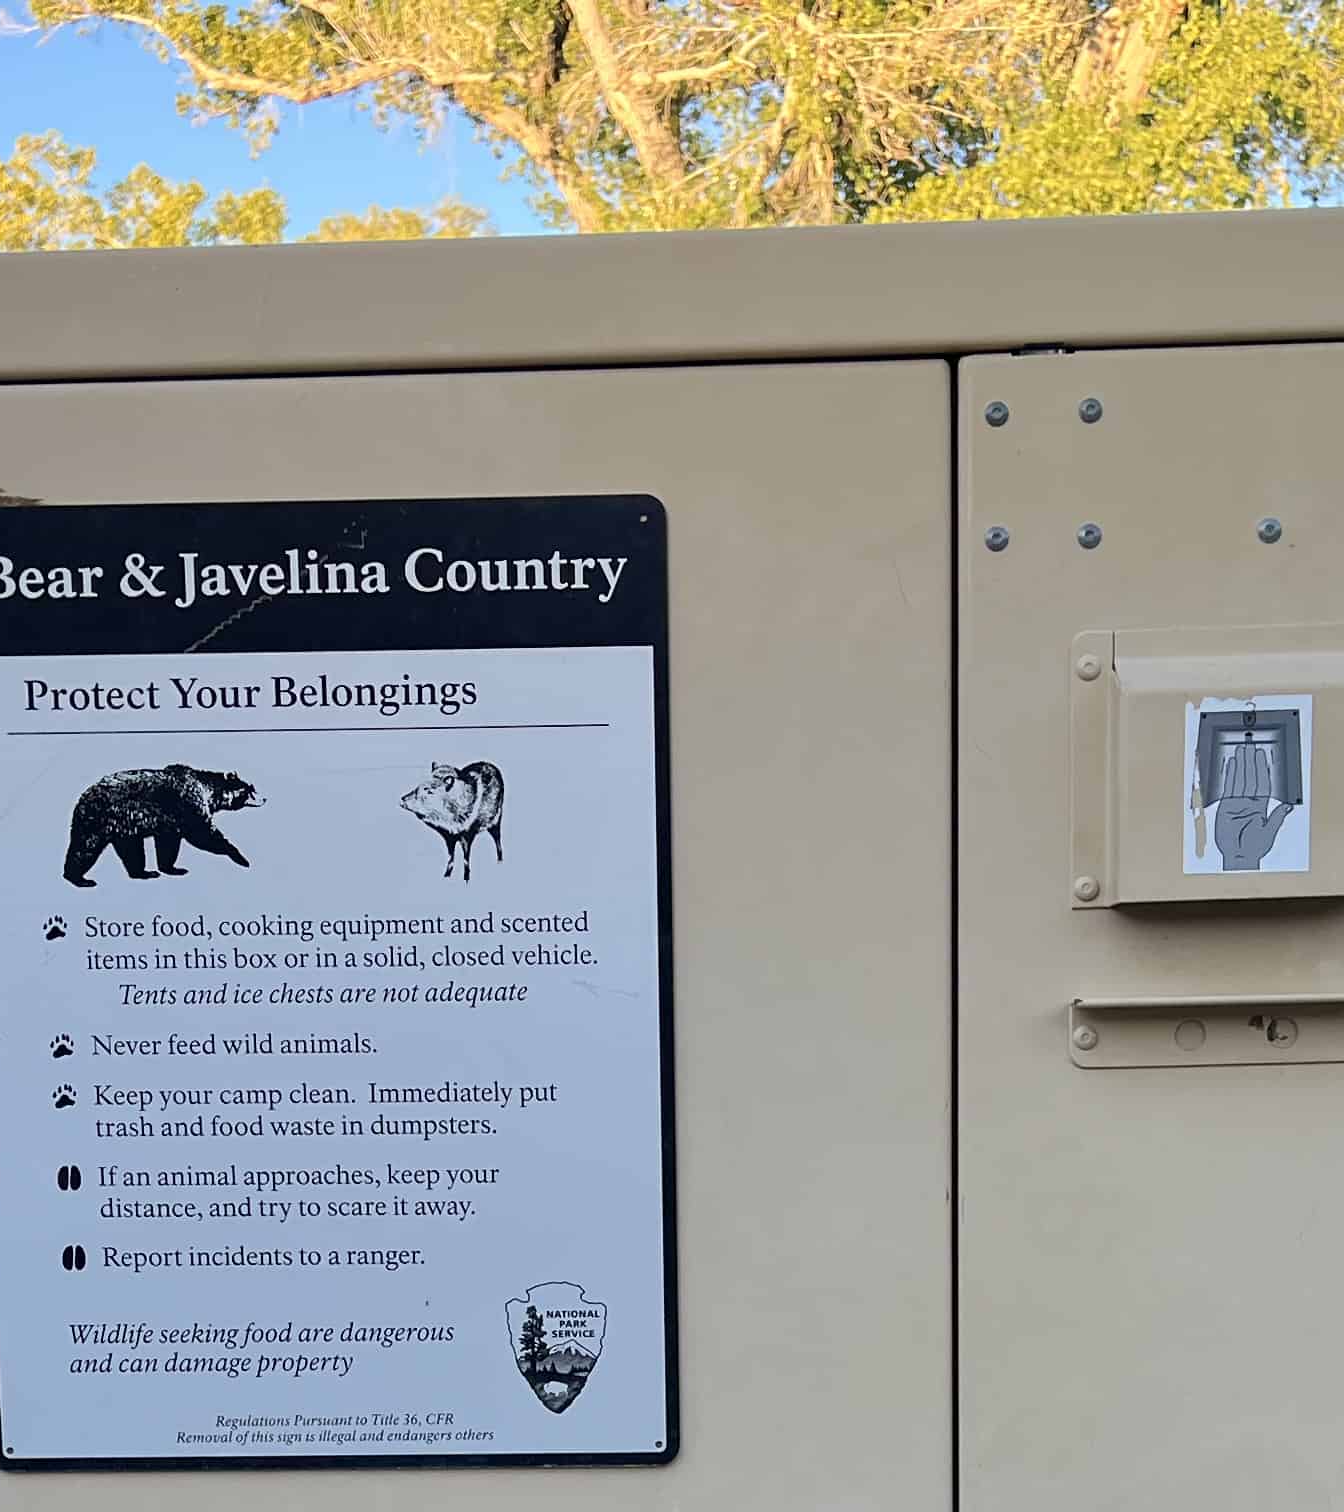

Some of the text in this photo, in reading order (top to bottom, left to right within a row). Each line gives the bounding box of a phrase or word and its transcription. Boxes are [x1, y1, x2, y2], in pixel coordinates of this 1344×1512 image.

[119, 552, 167, 598] &
[174, 548, 391, 609] Javelina
[404, 547, 628, 603] Country
[23, 673, 477, 717] Protect Your Belongings
[85, 910, 589, 942] Store food, cooking equipment and scented
[87, 943, 598, 970] items in this box or in a solid, closed vehicle.
[119, 980, 528, 1009] Tents and ice chests are not adequate
[91, 1032, 377, 1056] Never feed wild animals.
[93, 1080, 558, 1112] Keep your camp clean. Immediately put
[95, 1113, 497, 1142] trash and food waste in dumpsters.
[97, 1163, 500, 1192] If an animal approaches, keep your
[100, 1195, 476, 1224] distance, and try to scare it away.
[102, 1245, 425, 1273] Report incidents to a ranger.
[545, 1309, 601, 1319] NATIONAL
[559, 1319, 588, 1329] PARK
[69, 1321, 455, 1350] Wildlife seeking food are dangerous
[551, 1329, 596, 1339] SERVICE
[69, 1352, 354, 1378] and can damage property
[215, 1412, 454, 1431] Regulations Pursuant to Title 36, CFR
[176, 1428, 494, 1446] Removal of this sign is illegal and endangers others
